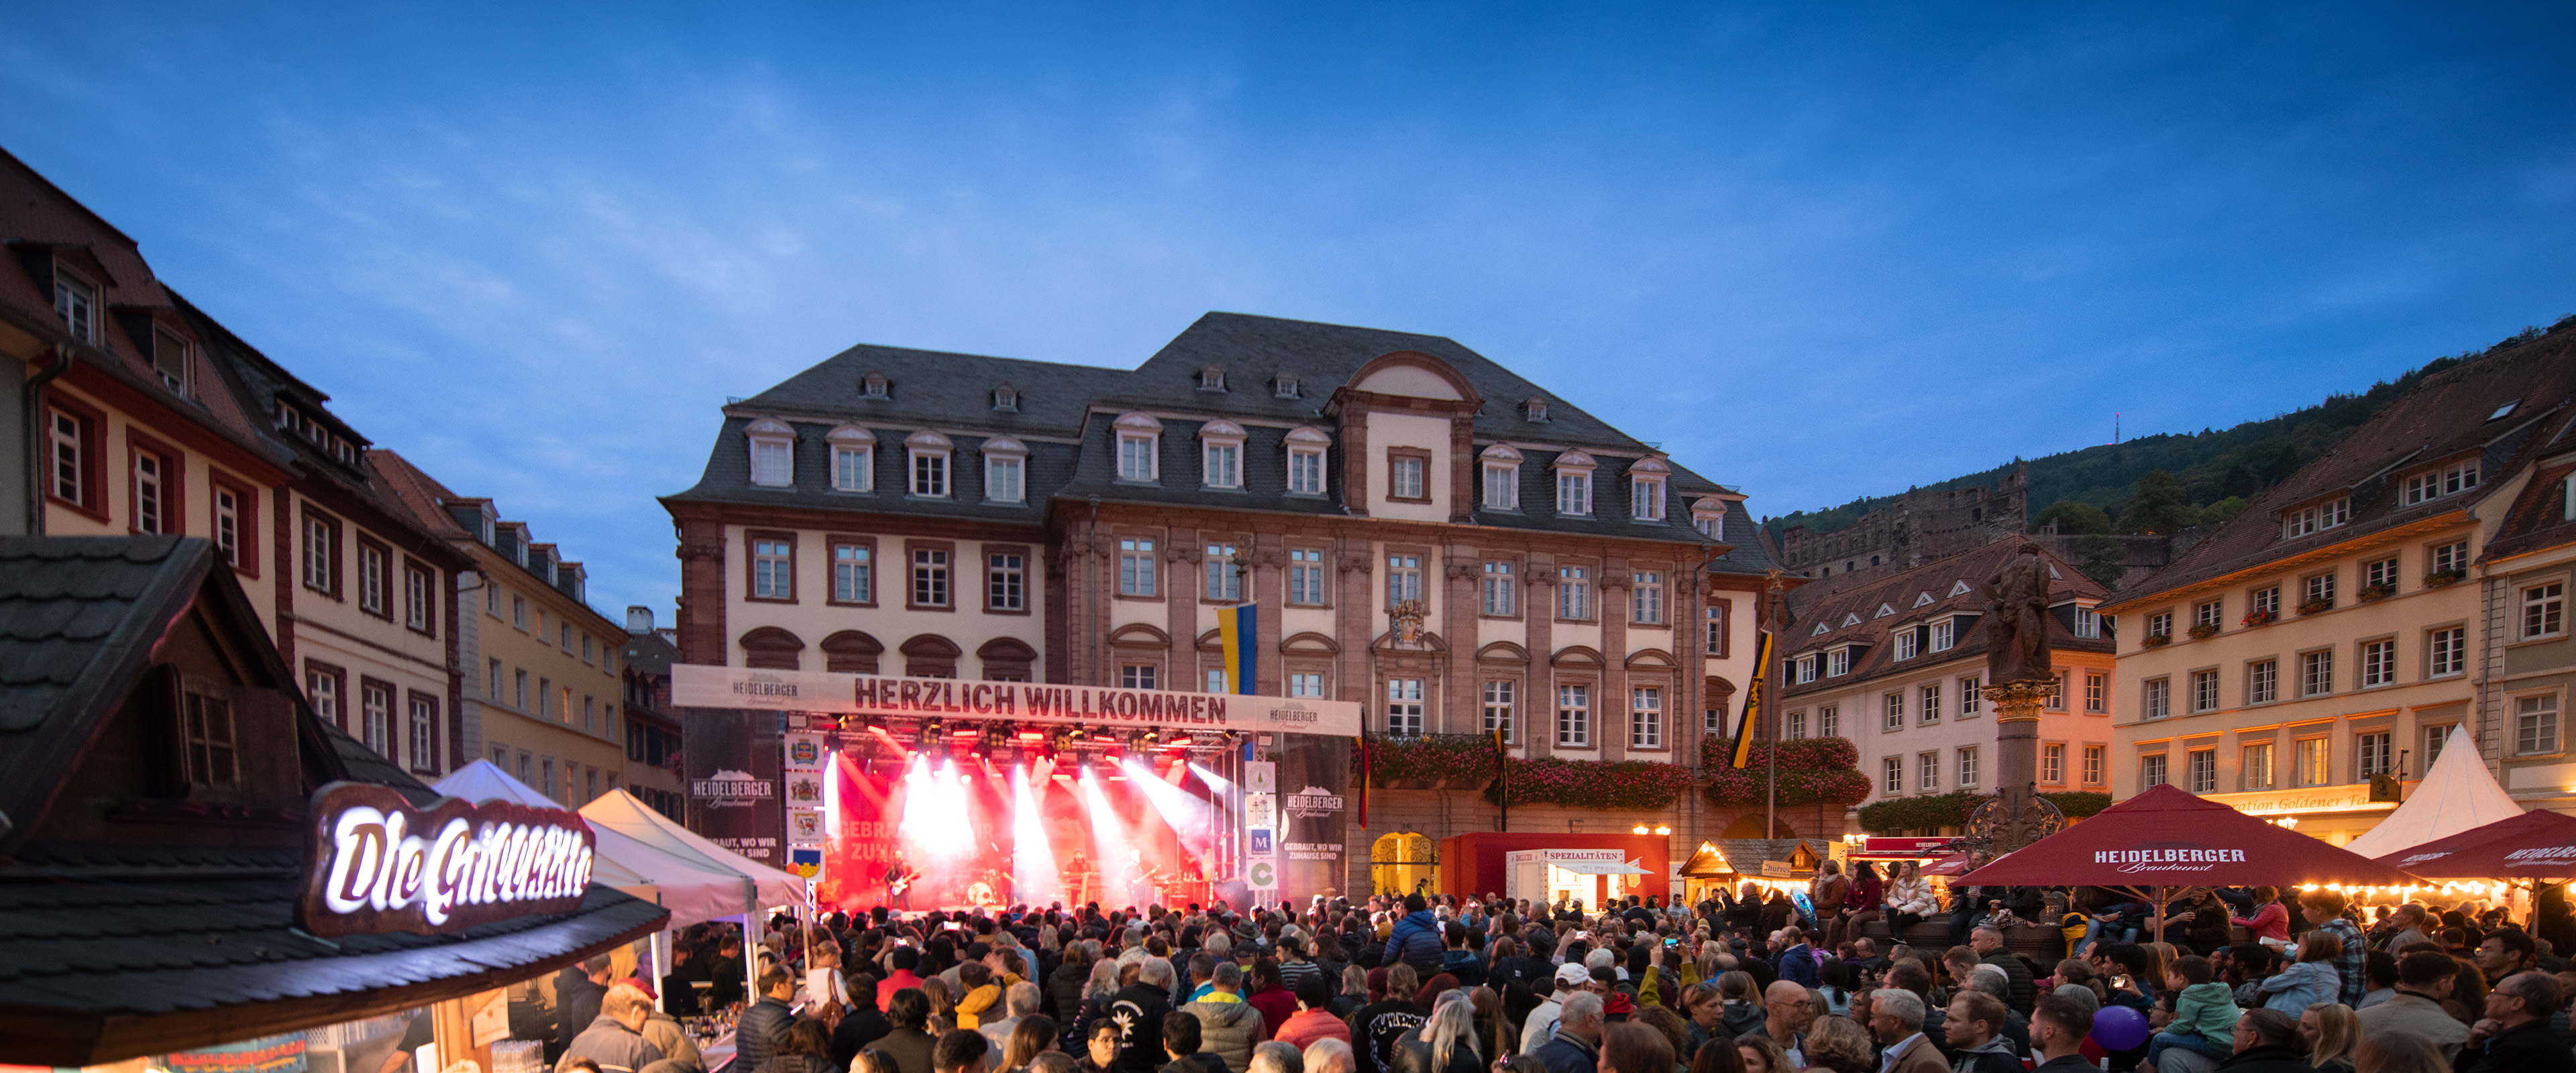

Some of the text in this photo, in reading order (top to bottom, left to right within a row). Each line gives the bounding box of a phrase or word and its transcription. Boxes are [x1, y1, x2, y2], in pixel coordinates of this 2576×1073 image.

[733, 681, 798, 697] HEIDELBERGER
[855, 677, 1226, 724] HERZLICH WILLKOMMEN
[1270, 709, 1318, 722] HEIDELBERGER
[693, 781, 772, 797] HEIDELBERGER
[1287, 795, 1342, 809] HEIDELBERGER
[2280, 795, 2344, 811] Goldener
[741, 838, 757, 847] WO
[758, 838, 776, 847] WIR
[1284, 843, 1316, 852] GEBRAUT,
[1329, 844, 1342, 852] WIR
[326, 806, 425, 913] Die
[747, 848, 770, 858] SIND
[1289, 852, 1320, 860] ZUHAUSE
[1550, 851, 1617, 860] SPEZIALITÄTEN
[2095, 849, 2246, 864] HEIDELBERGER
[2116, 862, 2214, 874] Braukunst
